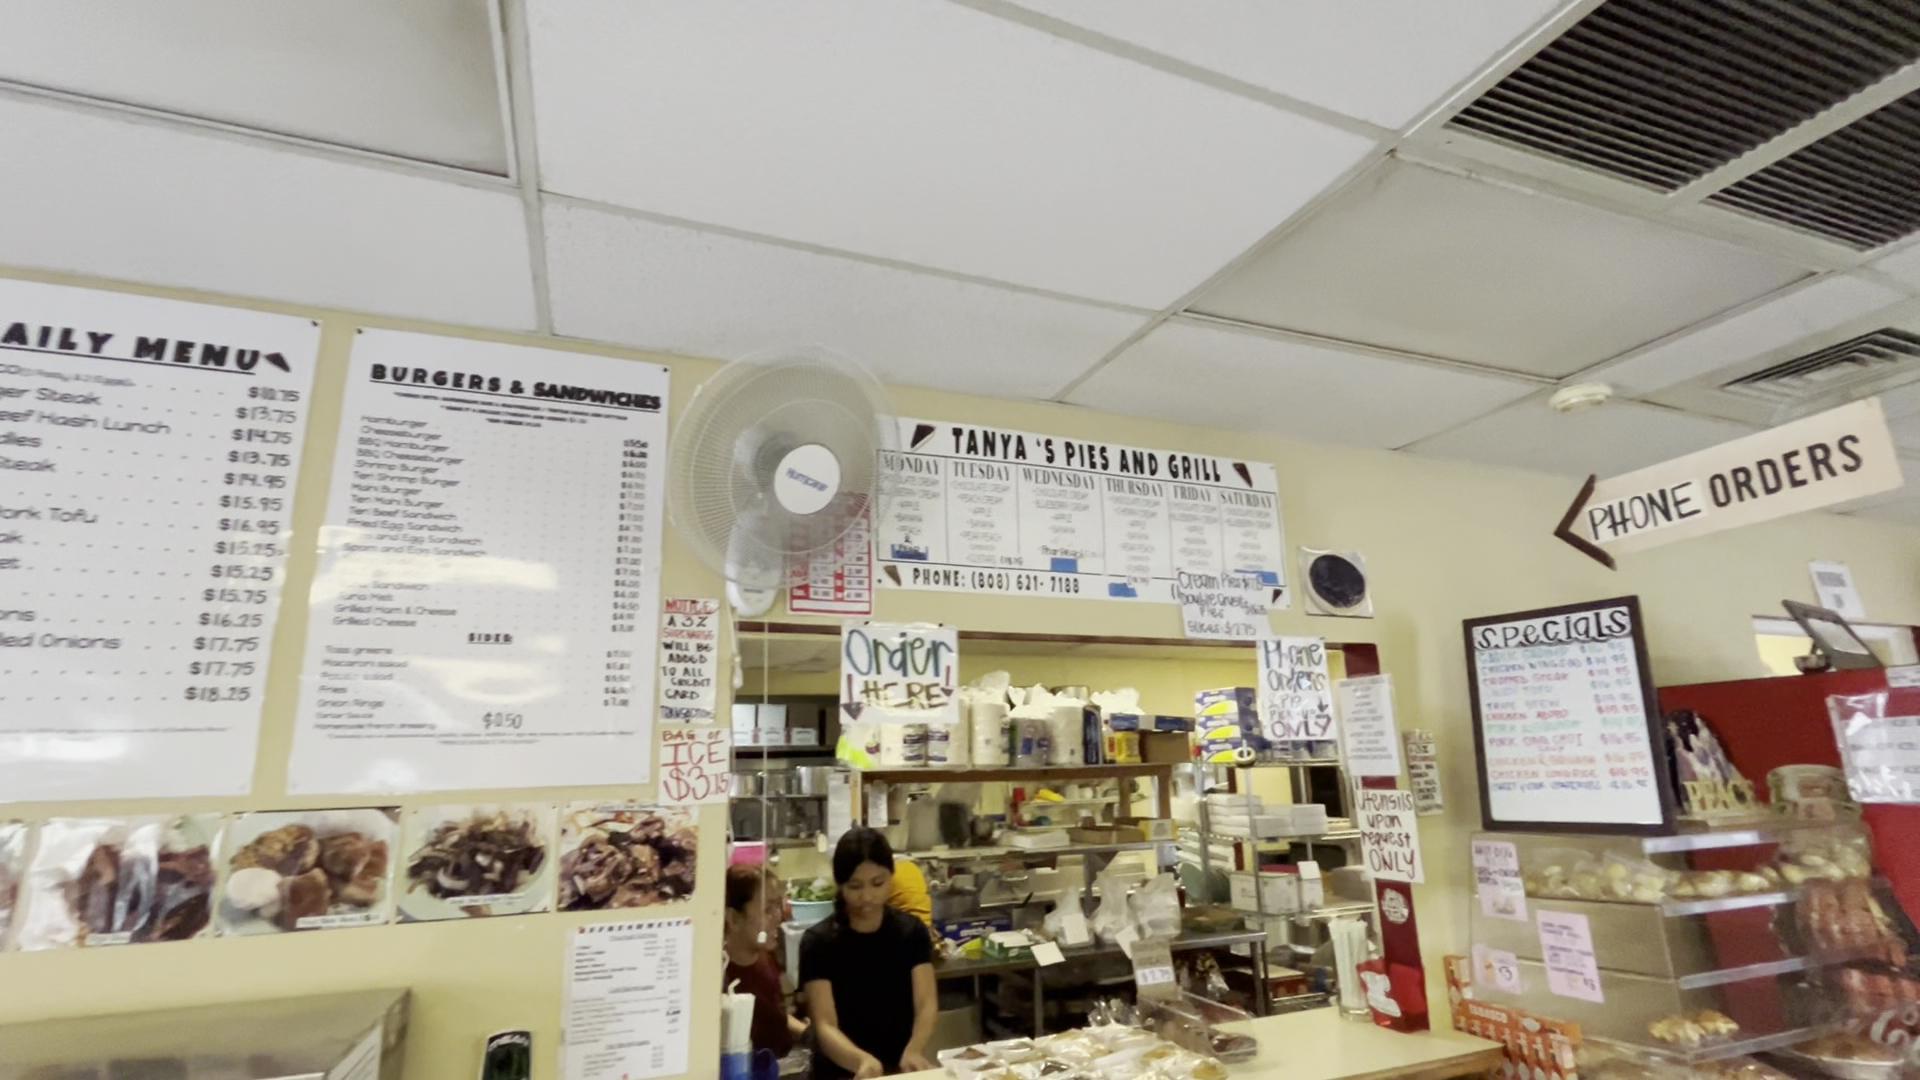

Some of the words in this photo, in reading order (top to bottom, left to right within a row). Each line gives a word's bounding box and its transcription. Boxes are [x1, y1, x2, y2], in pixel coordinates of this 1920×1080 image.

[133, 336, 260, 371] MENU
[36, 387, 101, 405] Steak
[371, 363, 501, 393] BURGERS
[510, 379, 525, 395] &
[533, 382, 662, 411] SANDWICHES
[38, 410, 97, 428] Hash
[102, 416, 172, 434] Lunch
[236, 406, 297, 424] $13.75
[1064, 441, 1110, 470] PIES
[1119, 449, 1159, 477] AND
[1167, 454, 1221, 483] GRILL
[884, 456, 939, 476] MONDAY
[953, 461, 1010, 481] TUESDAY
[1021, 467, 1096, 490] WEDNESDAY
[1105, 477, 1164, 498] THURSDAY
[1173, 485, 1212, 502] FRIDAY
[1219, 491, 1272, 509] SATURDAY
[1587, 481, 1702, 541] PHONE
[1709, 434, 1864, 509] ORDERS
[49, 507, 99, 524] Tofu
[219, 495, 284, 512] $15.95
[912, 567, 966, 588] PHONE:
[970, 571, 1011, 591] (808)
[1050, 576, 1081, 594] 7188
[1178, 571, 1219, 589] Cream
[199, 612, 263, 628] $16.25
[667, 616, 676, 627] A
[38, 633, 121, 650] Onions
[194, 636, 259, 652] $17.75
[845, 629, 955, 678] Order
[188, 661, 255, 677] $17.75
[859, 681, 948, 710] HERE
[661, 731, 696, 742] BAG
[1271, 714, 1333, 738] ONLY
[661, 741, 727, 766] ICE
[1369, 849, 1416, 880] ONLY
